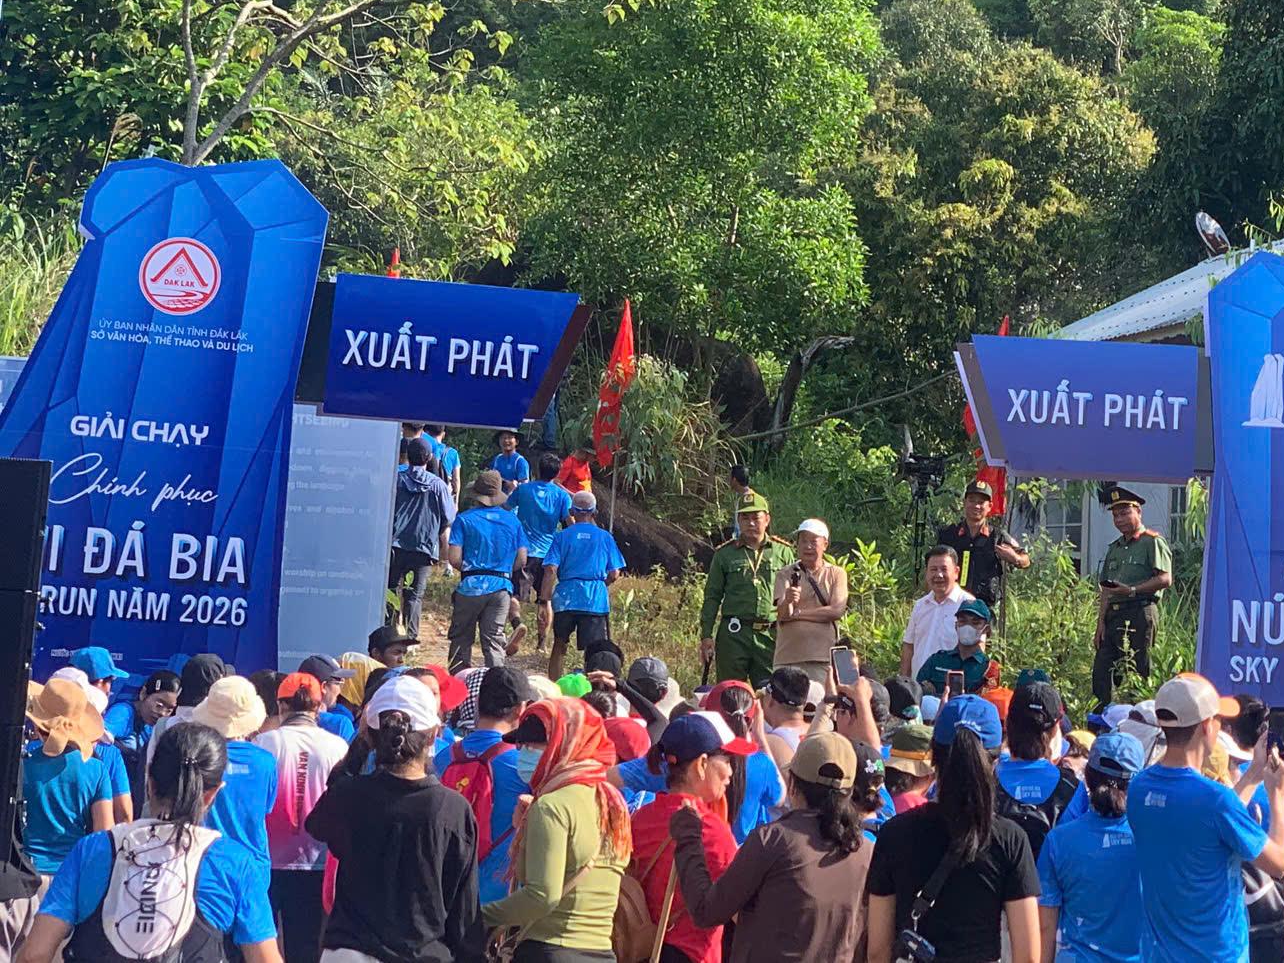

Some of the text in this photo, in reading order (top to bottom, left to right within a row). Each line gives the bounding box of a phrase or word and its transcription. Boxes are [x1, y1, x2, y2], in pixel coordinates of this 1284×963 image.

[107, 331, 127, 341] VĂN
[173, 337, 200, 348] THAO
[216, 341, 231, 350] DU
[114, 320, 134, 331] BAN
[342, 321, 540, 379] XUẤT PHÁT
[1006, 379, 1189, 430] XUẤT PHÁT
[70, 412, 209, 448] GIẢI CHẠY
[48, 452, 219, 512] Chính phục
[84, 521, 147, 577] ĐÁ
[169, 533, 247, 584] BIA
[40, 585, 248, 627] RUN NĂM 2026
[1229, 655, 1279, 684] SKY
